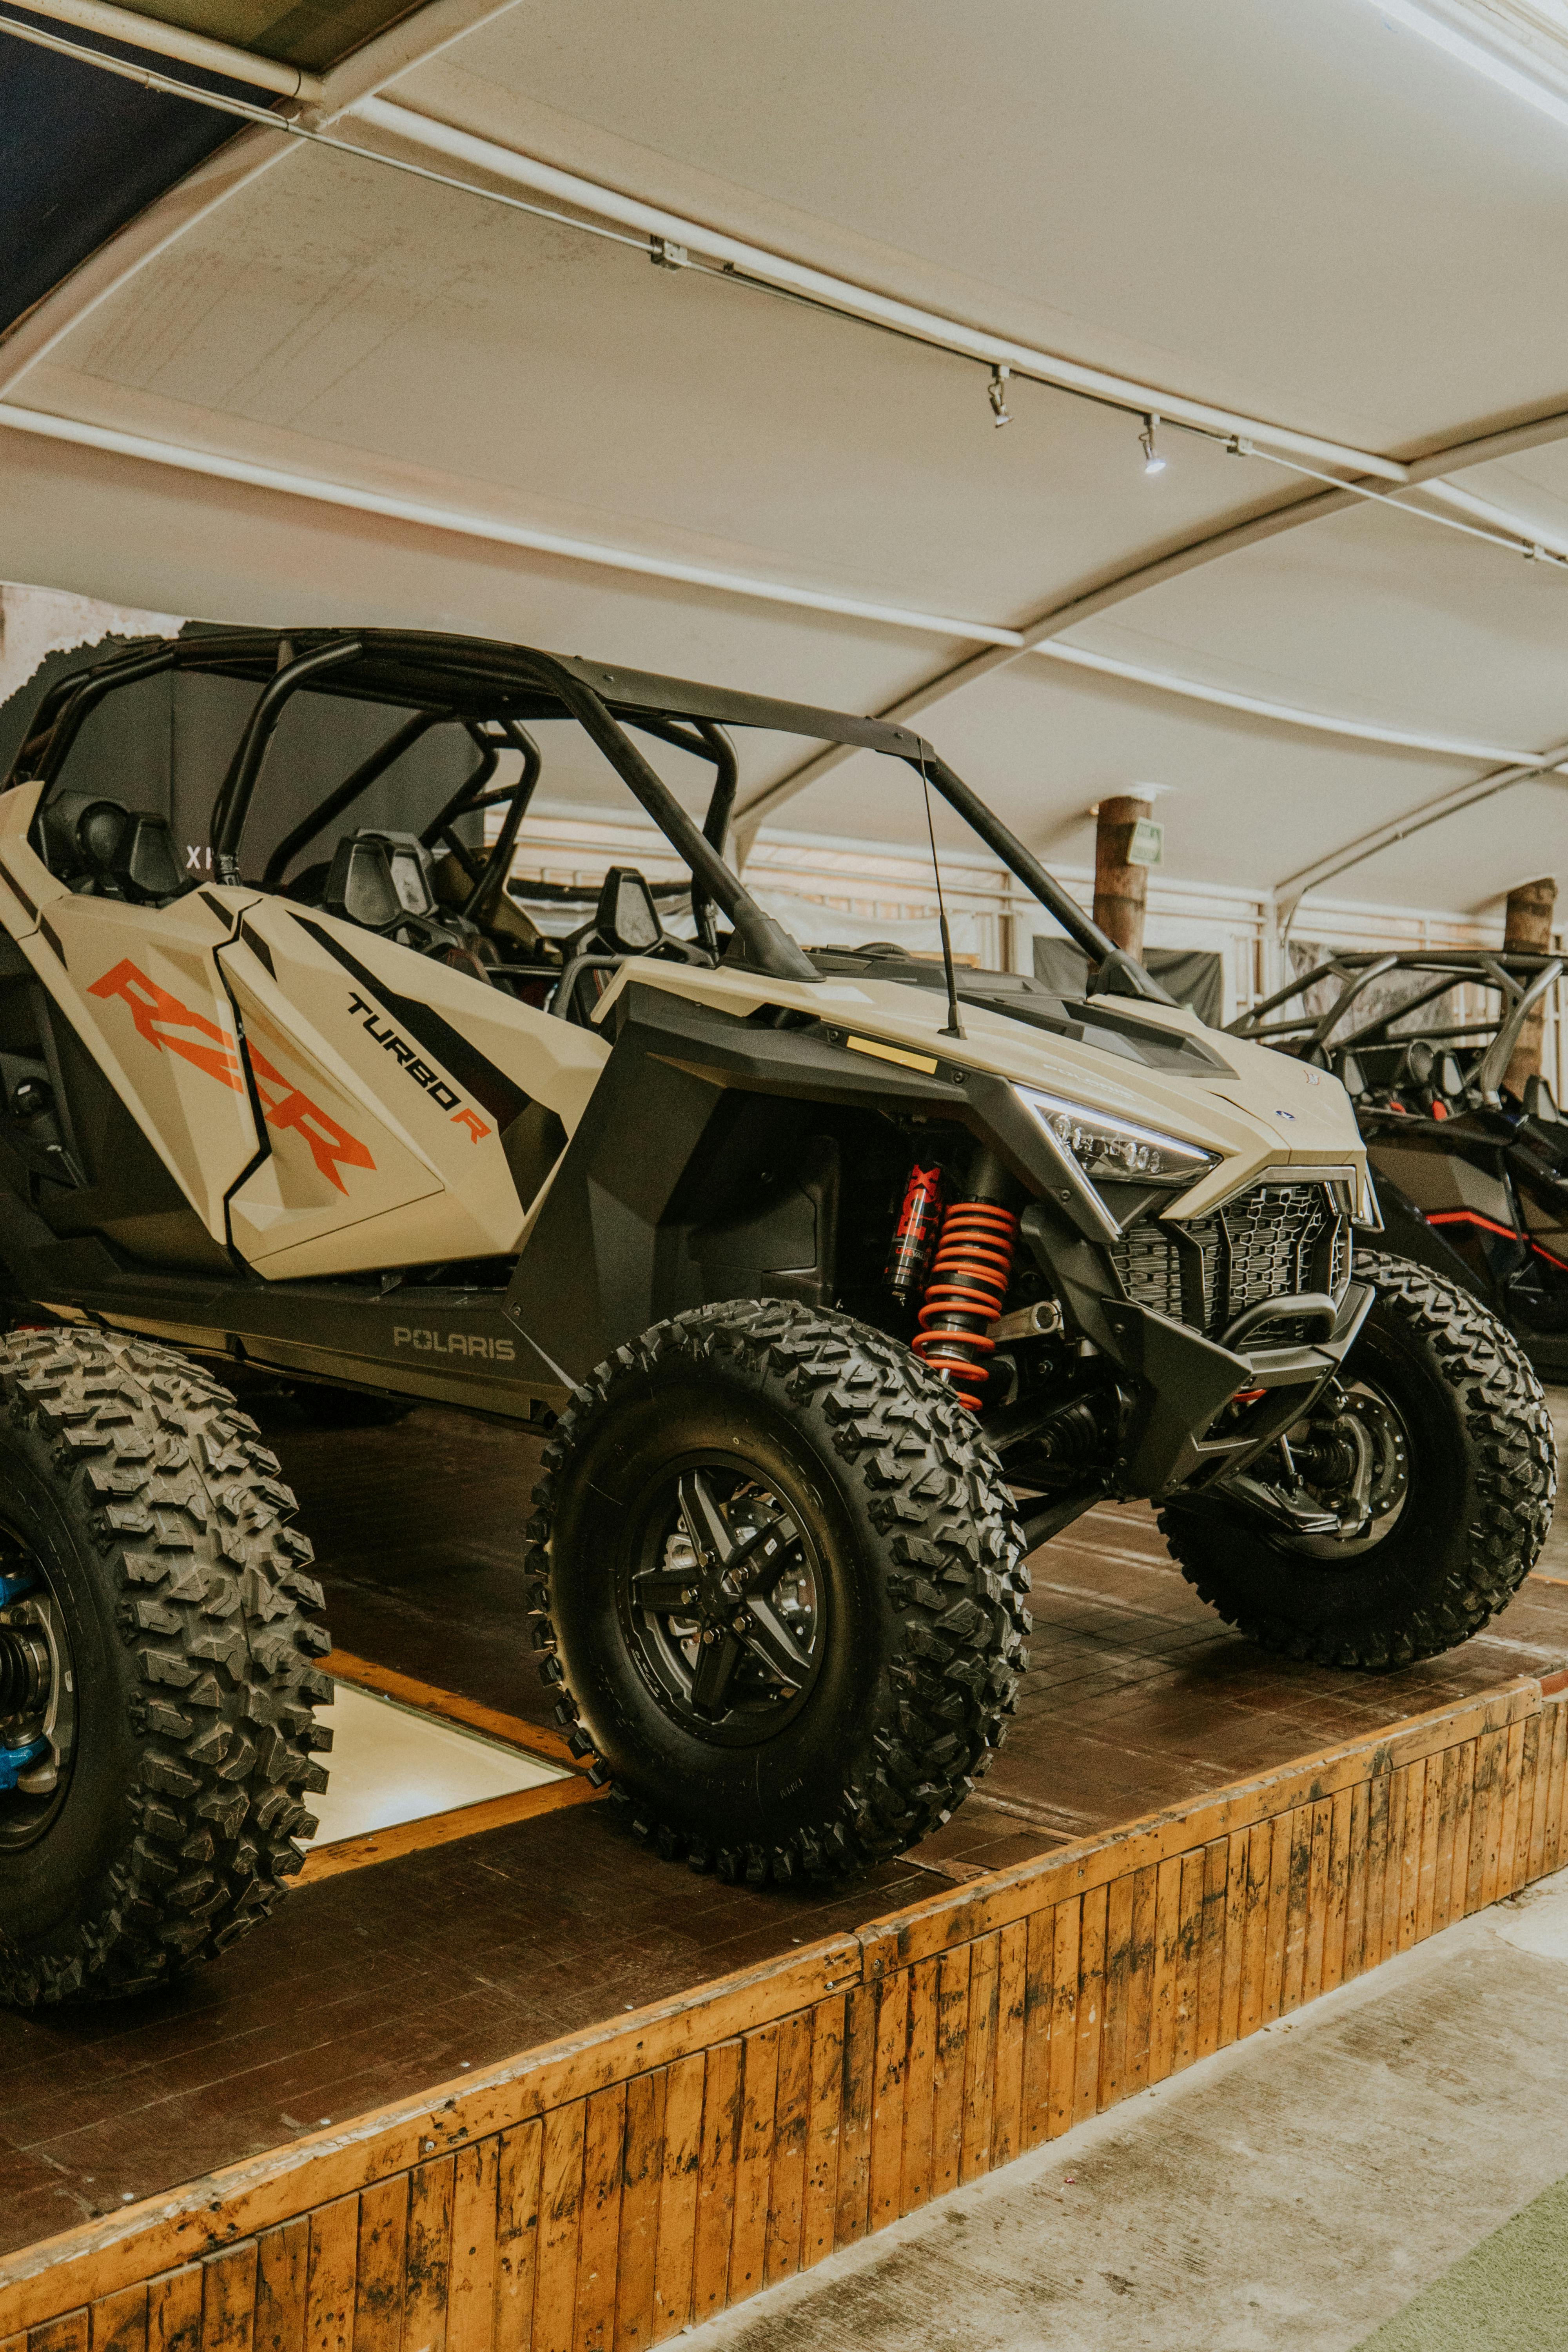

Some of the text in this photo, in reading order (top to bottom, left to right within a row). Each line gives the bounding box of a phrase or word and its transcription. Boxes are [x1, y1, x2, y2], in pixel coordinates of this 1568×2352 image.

[87, 958, 377, 1196] RZR
[348, 992, 492, 1144] TURBO R
[897, 1164, 941, 1241] FOX
[393, 1326, 516, 1361] POLARIS
